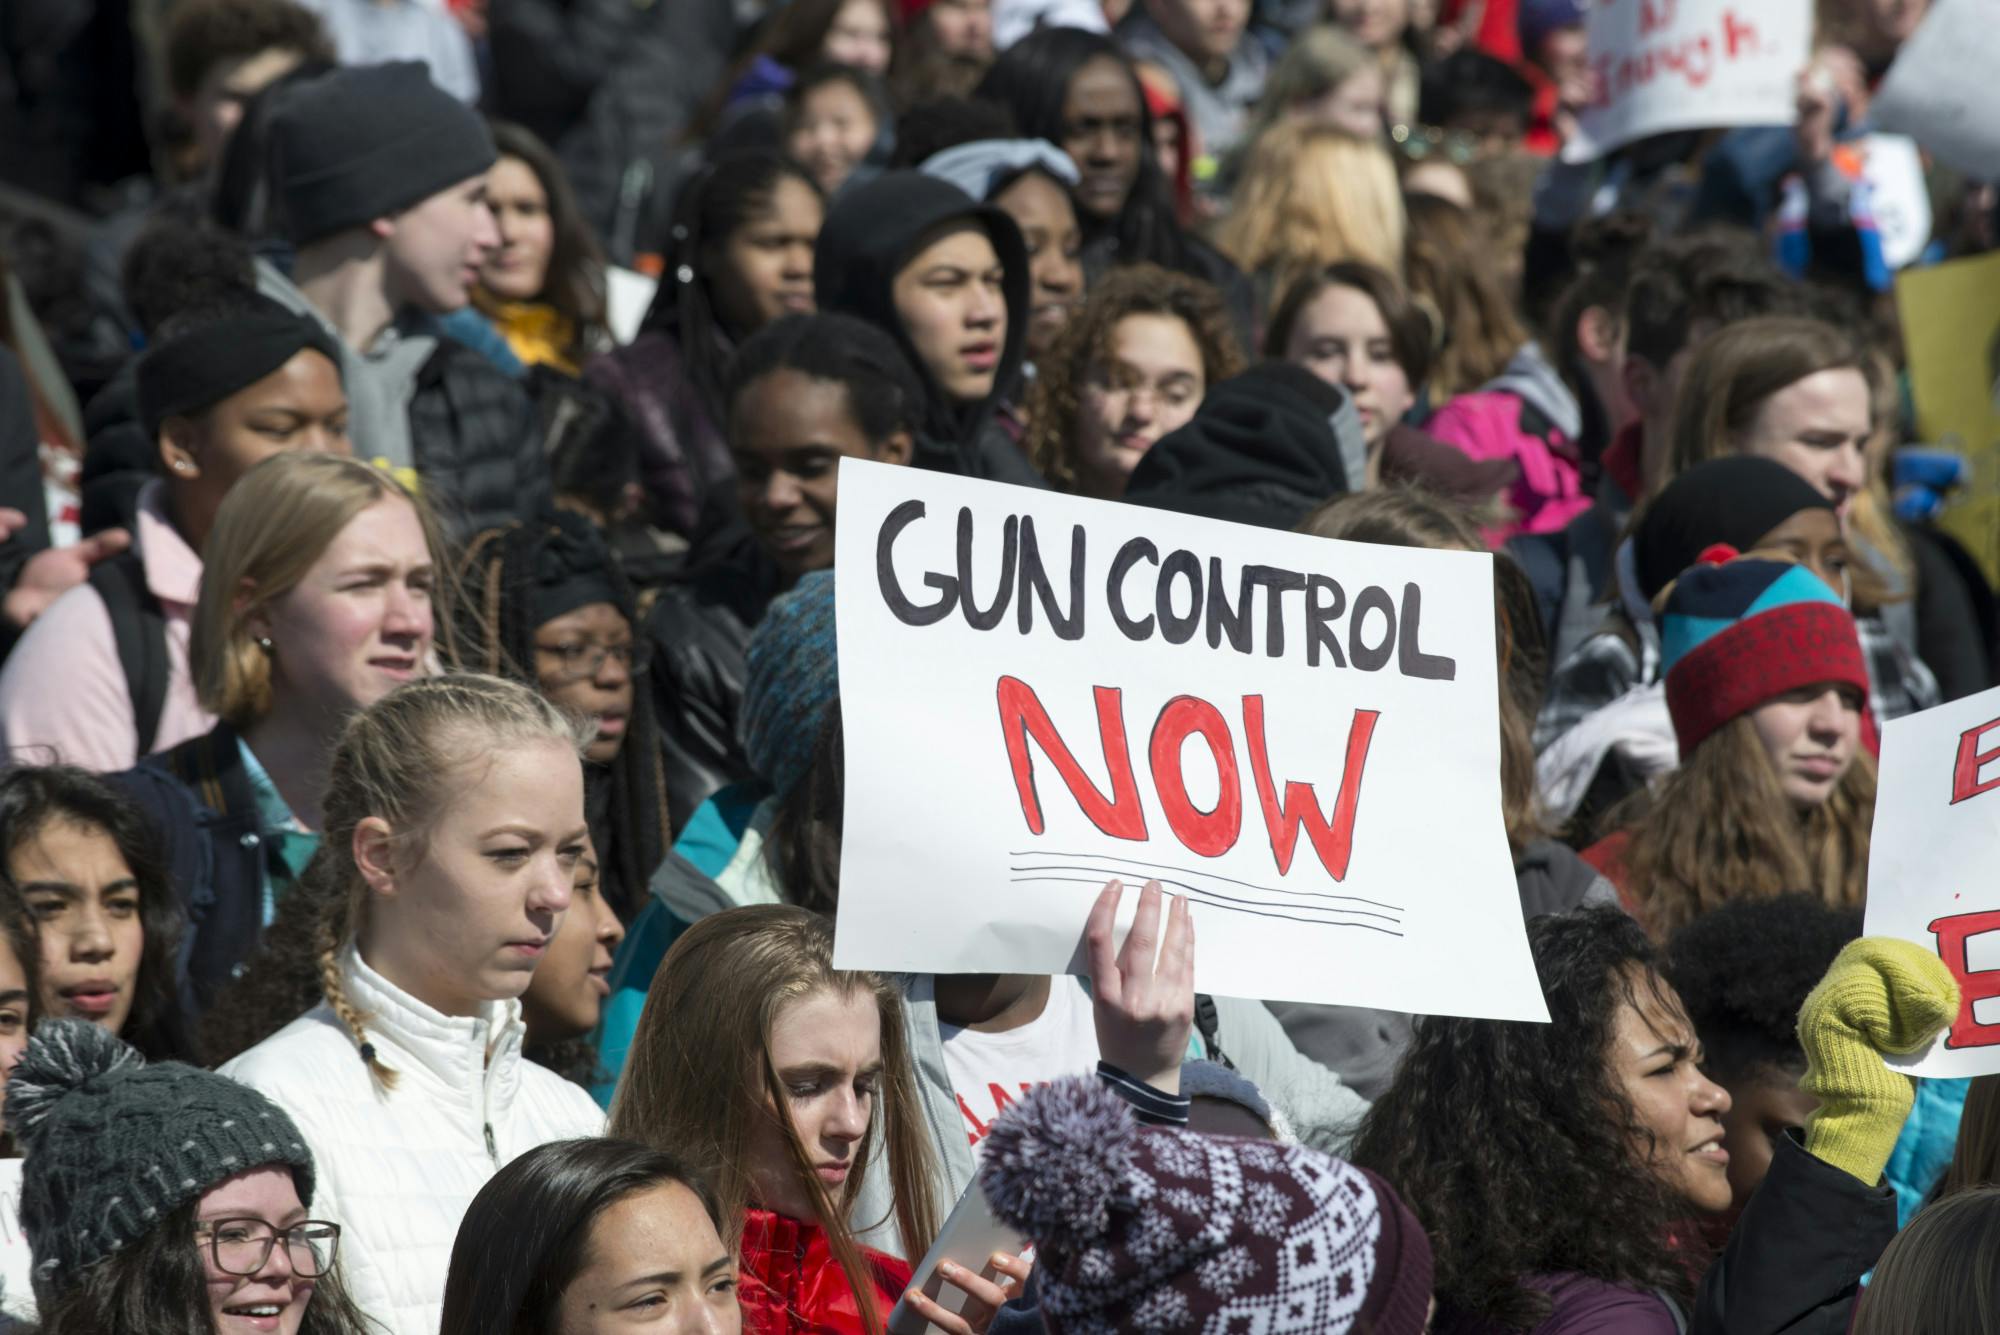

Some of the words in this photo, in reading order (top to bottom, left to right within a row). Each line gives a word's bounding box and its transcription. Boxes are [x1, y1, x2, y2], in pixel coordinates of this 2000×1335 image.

[876, 499, 1086, 641] GUN
[1107, 536, 1456, 681] CONTROL
[997, 675, 1381, 882] NOW
